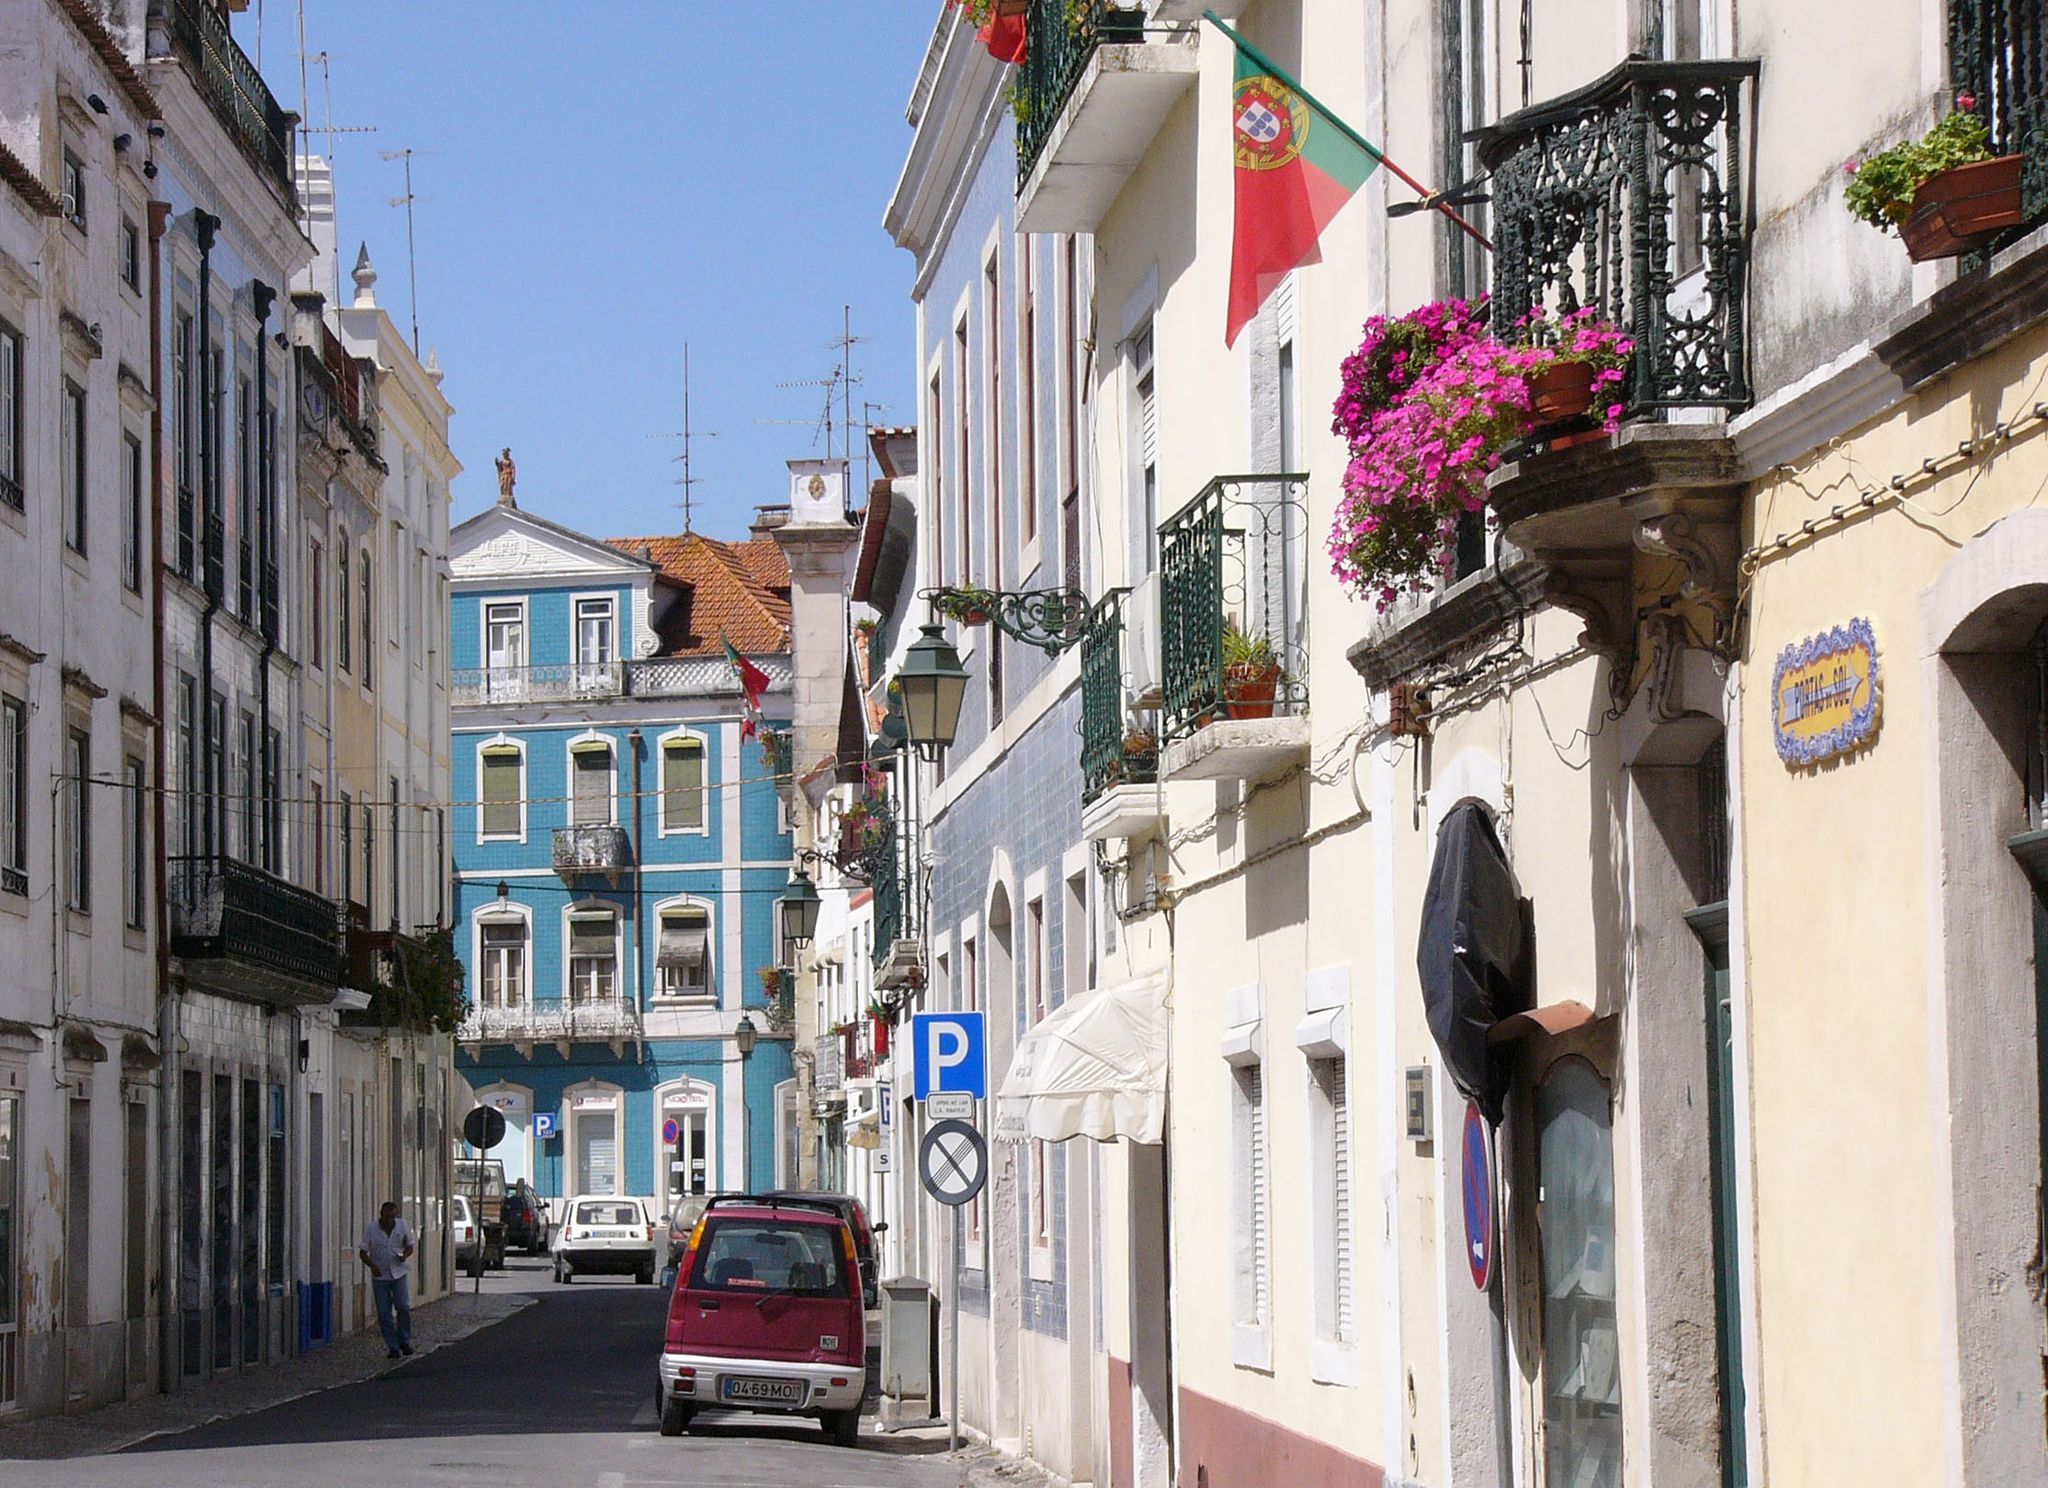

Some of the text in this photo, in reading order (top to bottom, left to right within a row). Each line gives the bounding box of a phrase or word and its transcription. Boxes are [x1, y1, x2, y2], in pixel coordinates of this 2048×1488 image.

[1794, 673, 1824, 719] PORTAS
[929, 1021, 969, 1091] P
[536, 1116, 551, 1136] P
[880, 1154, 889, 1165] S
